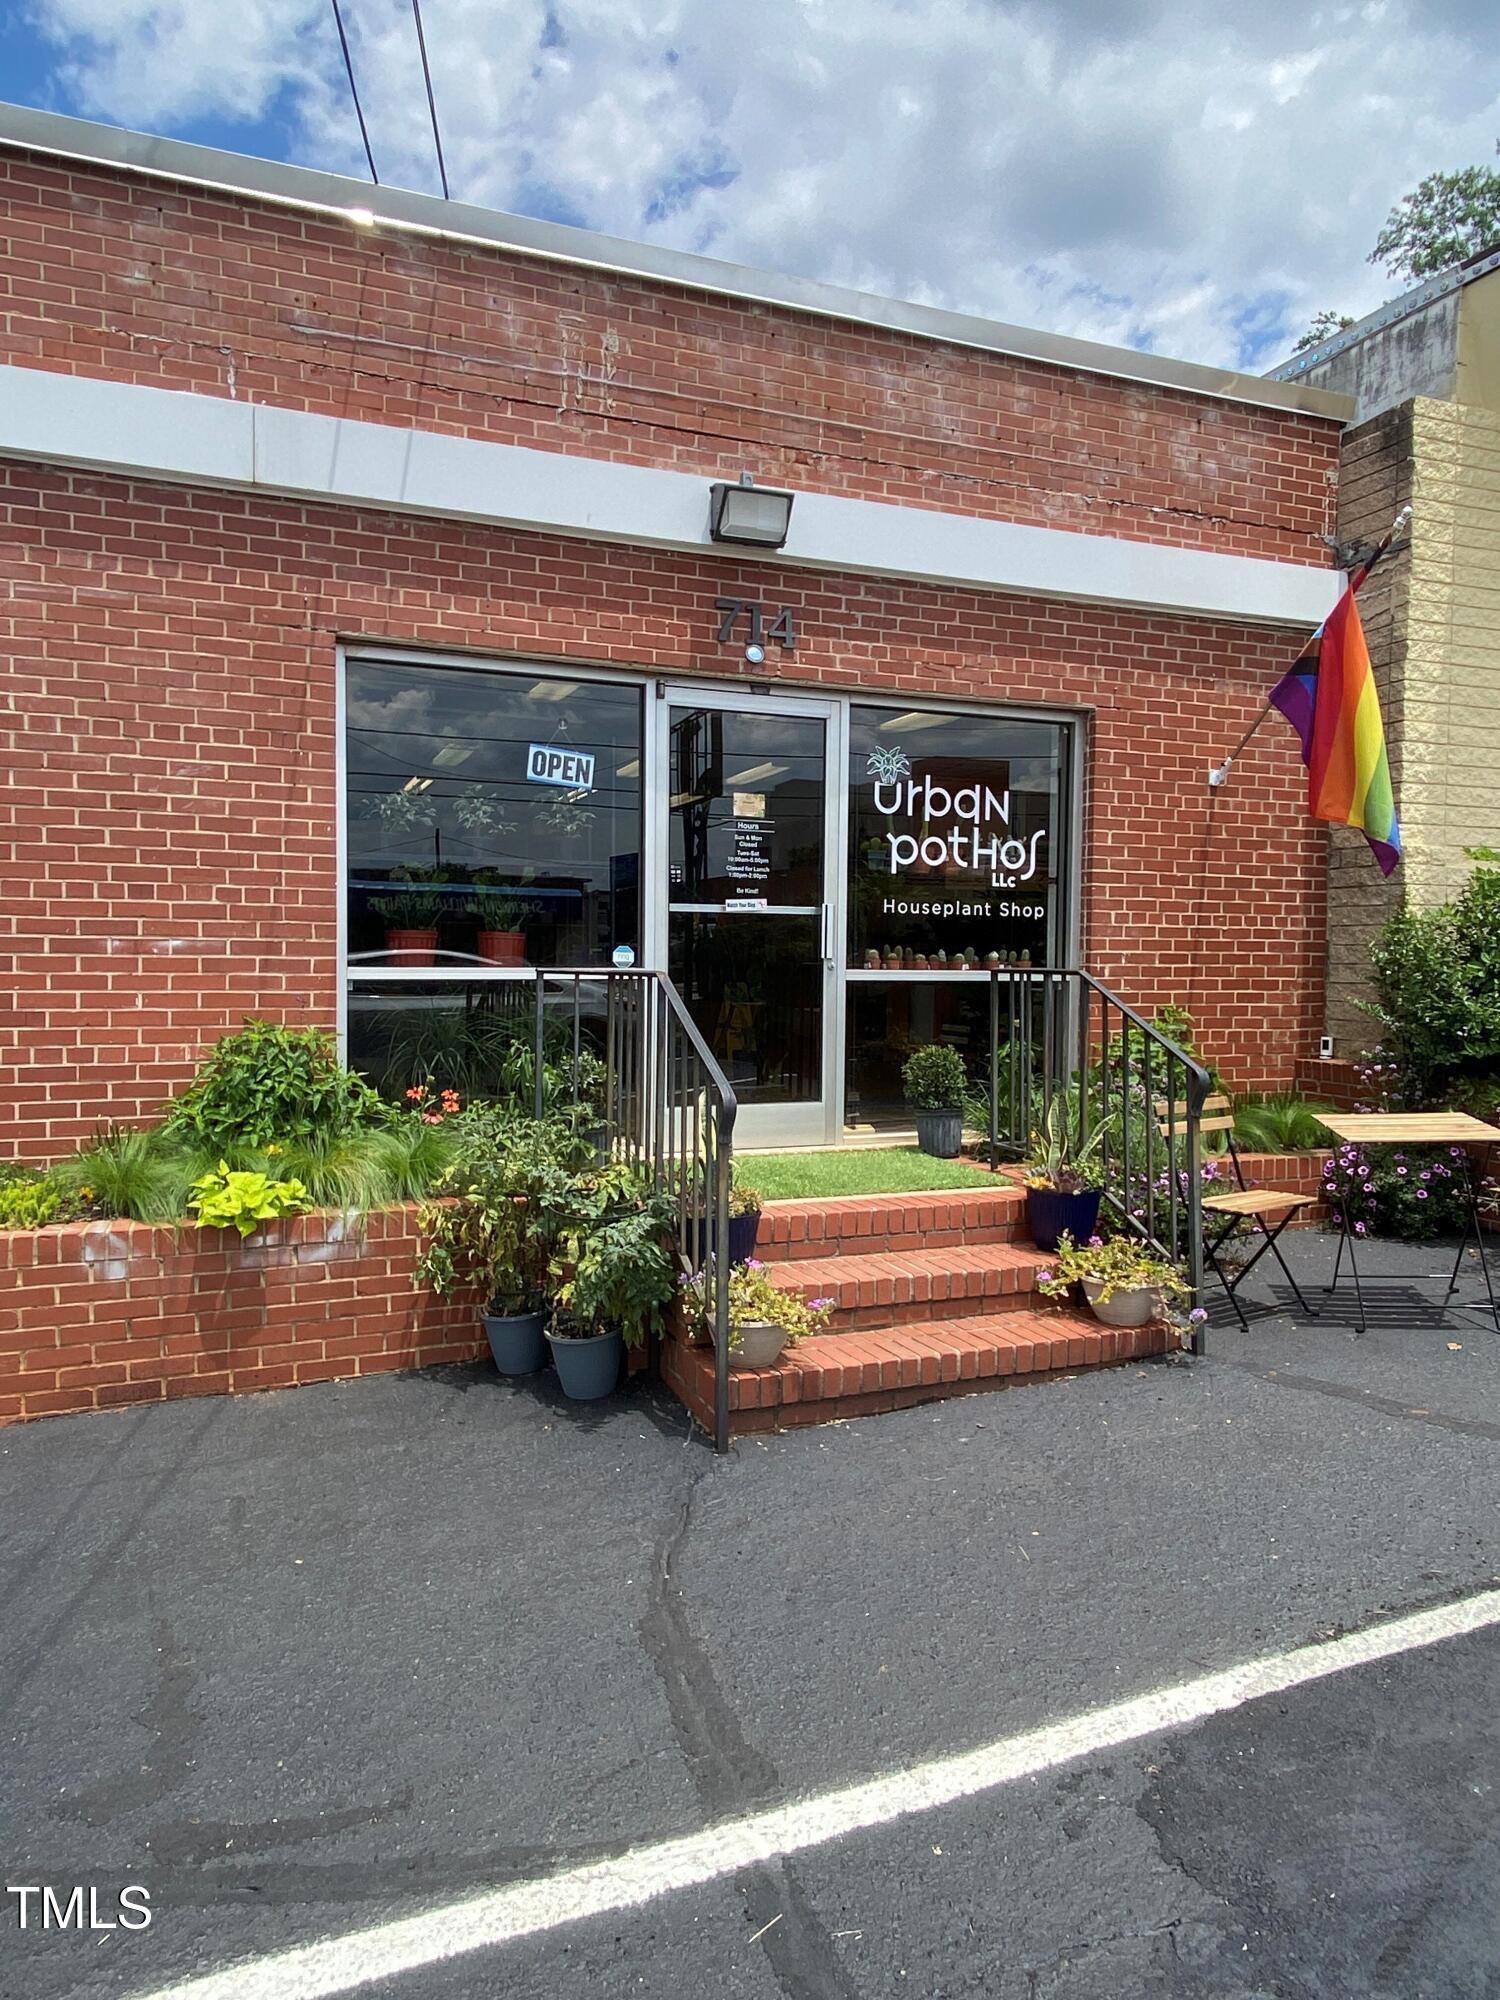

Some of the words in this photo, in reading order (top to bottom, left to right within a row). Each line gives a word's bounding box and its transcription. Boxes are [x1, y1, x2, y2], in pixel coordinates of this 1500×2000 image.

[715, 600, 796, 649] 714
[531, 750, 592, 785] OPEN
[883, 898, 992, 918] Houseplant
[999, 902, 1045, 921] Shop
